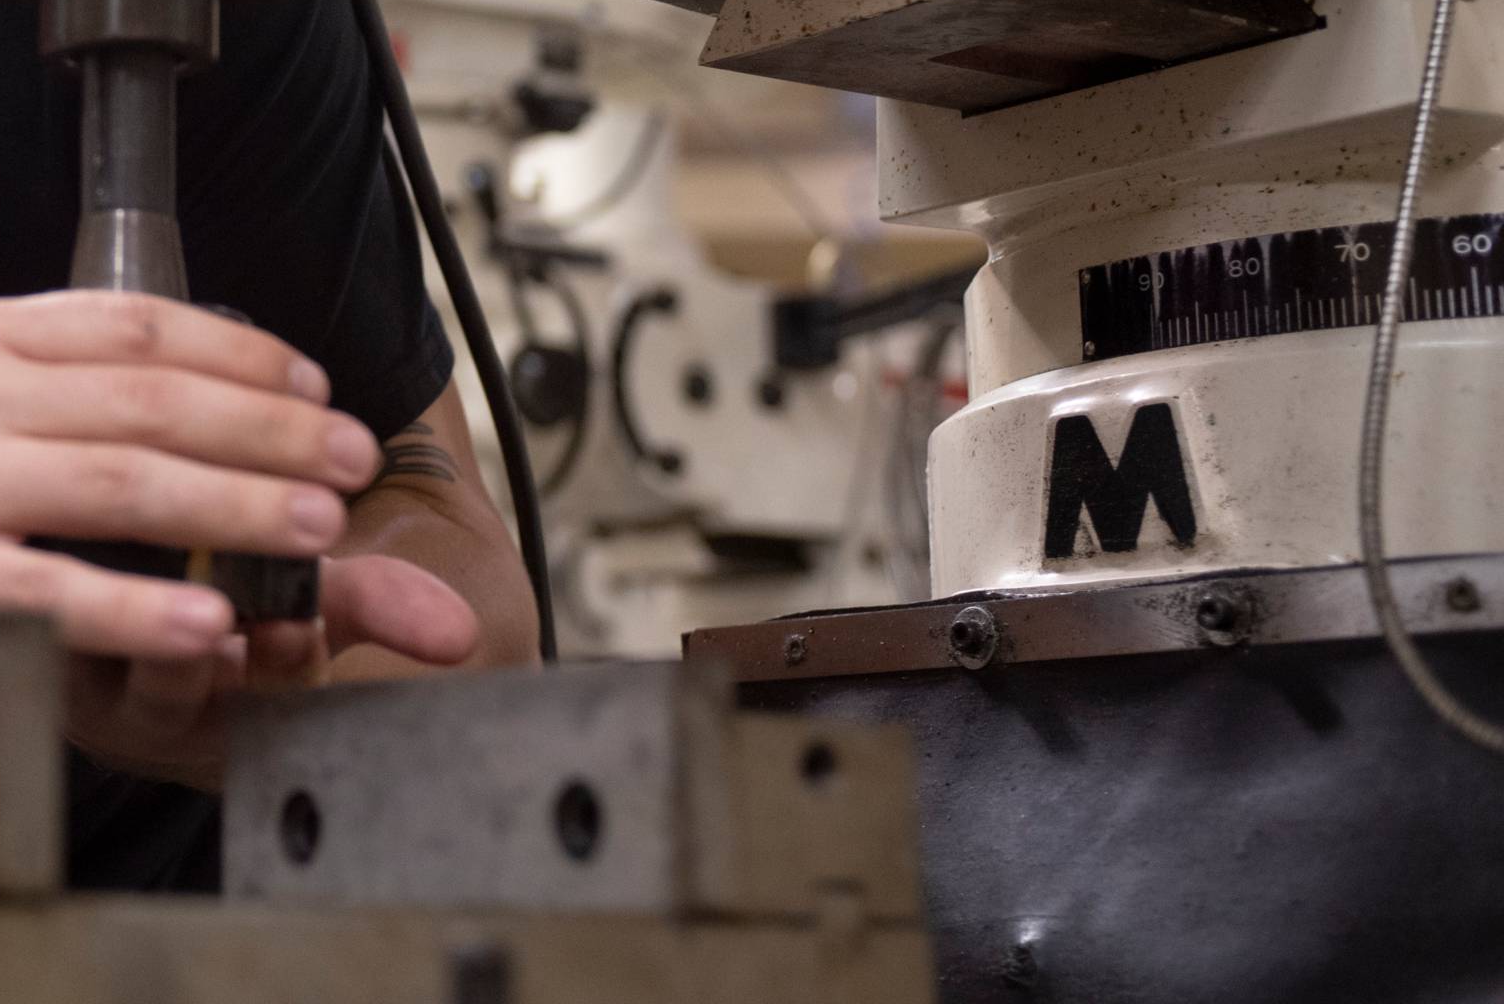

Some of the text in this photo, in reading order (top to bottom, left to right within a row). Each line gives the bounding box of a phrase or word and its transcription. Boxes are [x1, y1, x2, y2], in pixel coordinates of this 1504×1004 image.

[1138, 234, 1493, 291] 90 80 70 60
[1044, 402, 1197, 558] M
